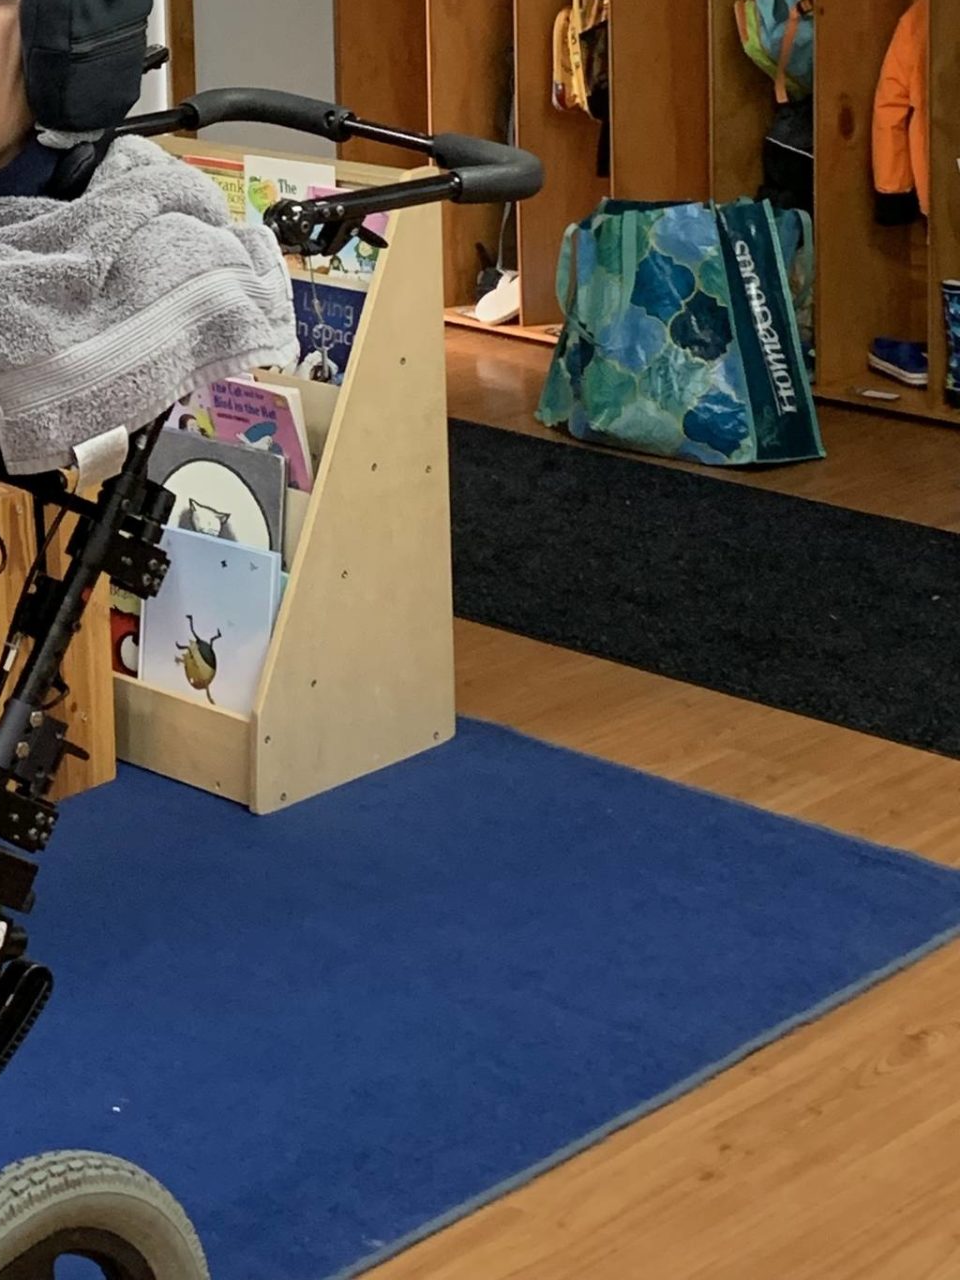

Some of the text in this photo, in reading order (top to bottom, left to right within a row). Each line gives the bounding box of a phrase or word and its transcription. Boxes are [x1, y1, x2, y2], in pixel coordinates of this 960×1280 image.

[277, 178, 297, 195] The
[303, 291, 354, 328] Lving
[312, 324, 354, 347] spac
